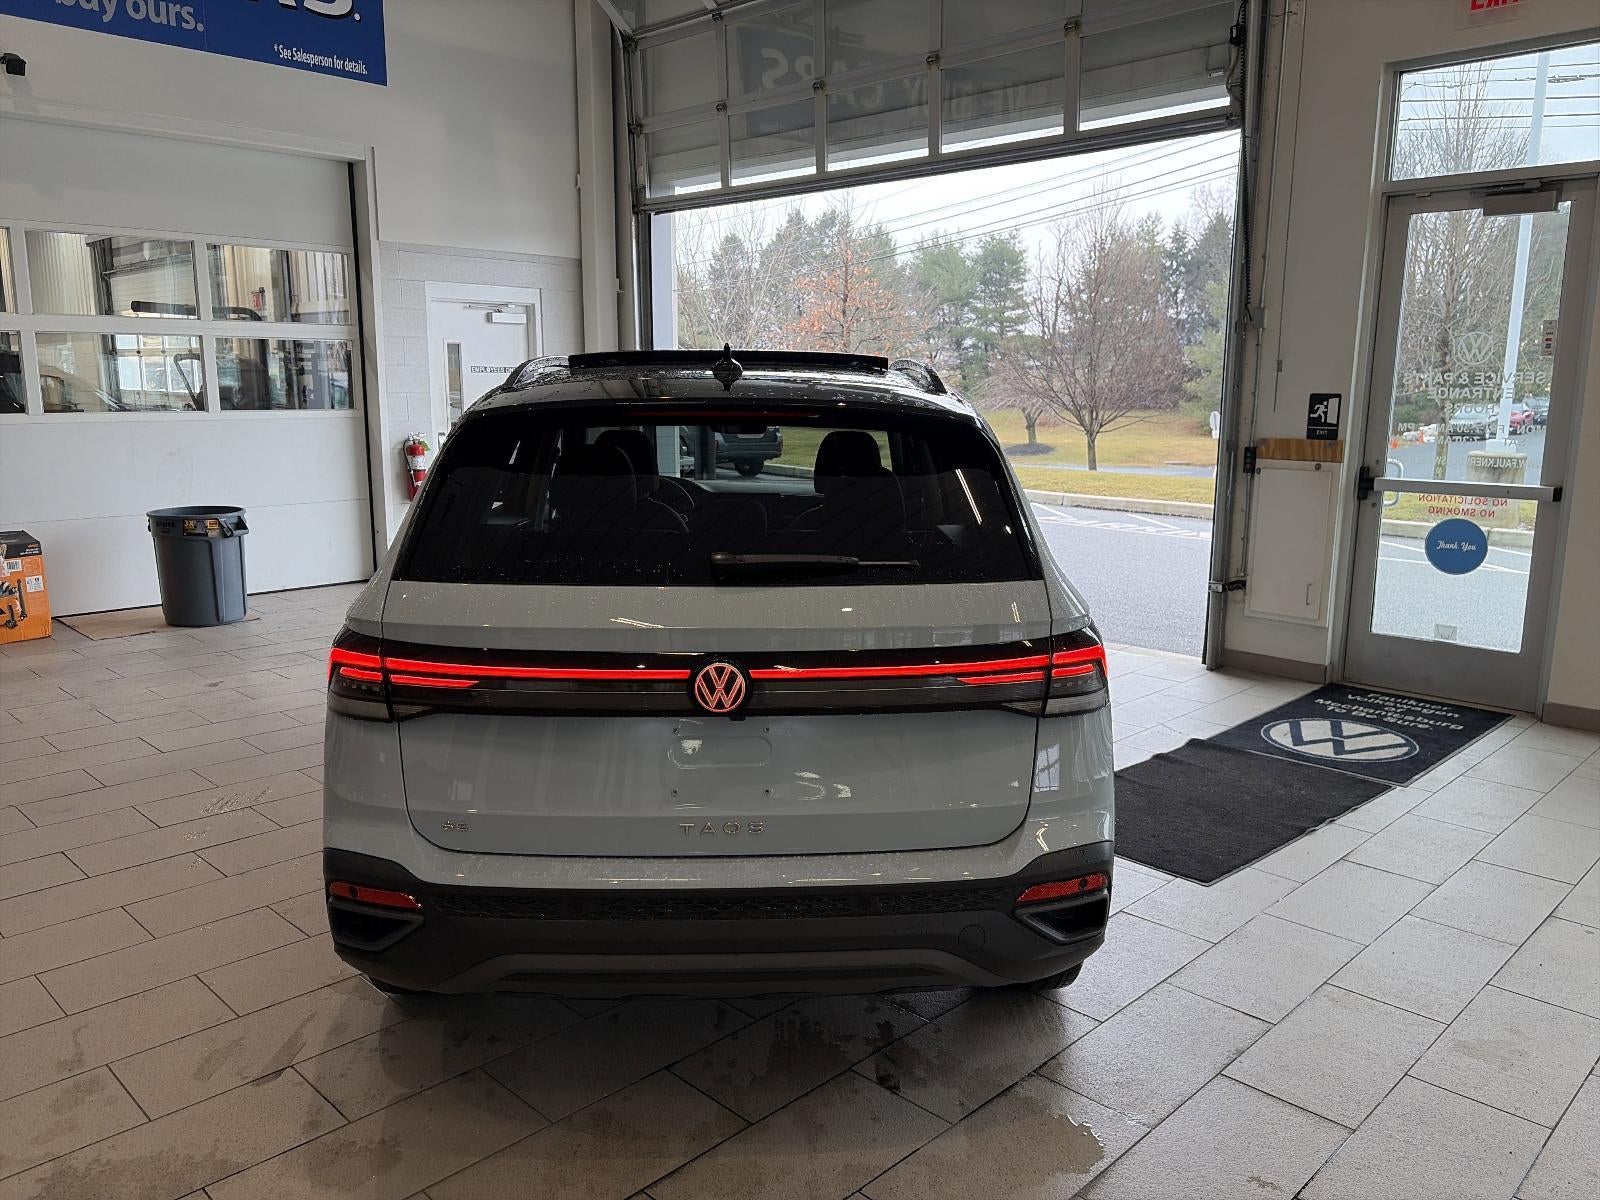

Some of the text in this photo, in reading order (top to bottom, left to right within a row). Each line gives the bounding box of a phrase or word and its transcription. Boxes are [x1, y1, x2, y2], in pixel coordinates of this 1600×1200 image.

[126, 0, 204, 32] ours.
[279, 45, 368, 75] See Salesperson for details.
[1436, 540, 1476, 552] Thank You
[679, 821, 766, 835] TAOS
